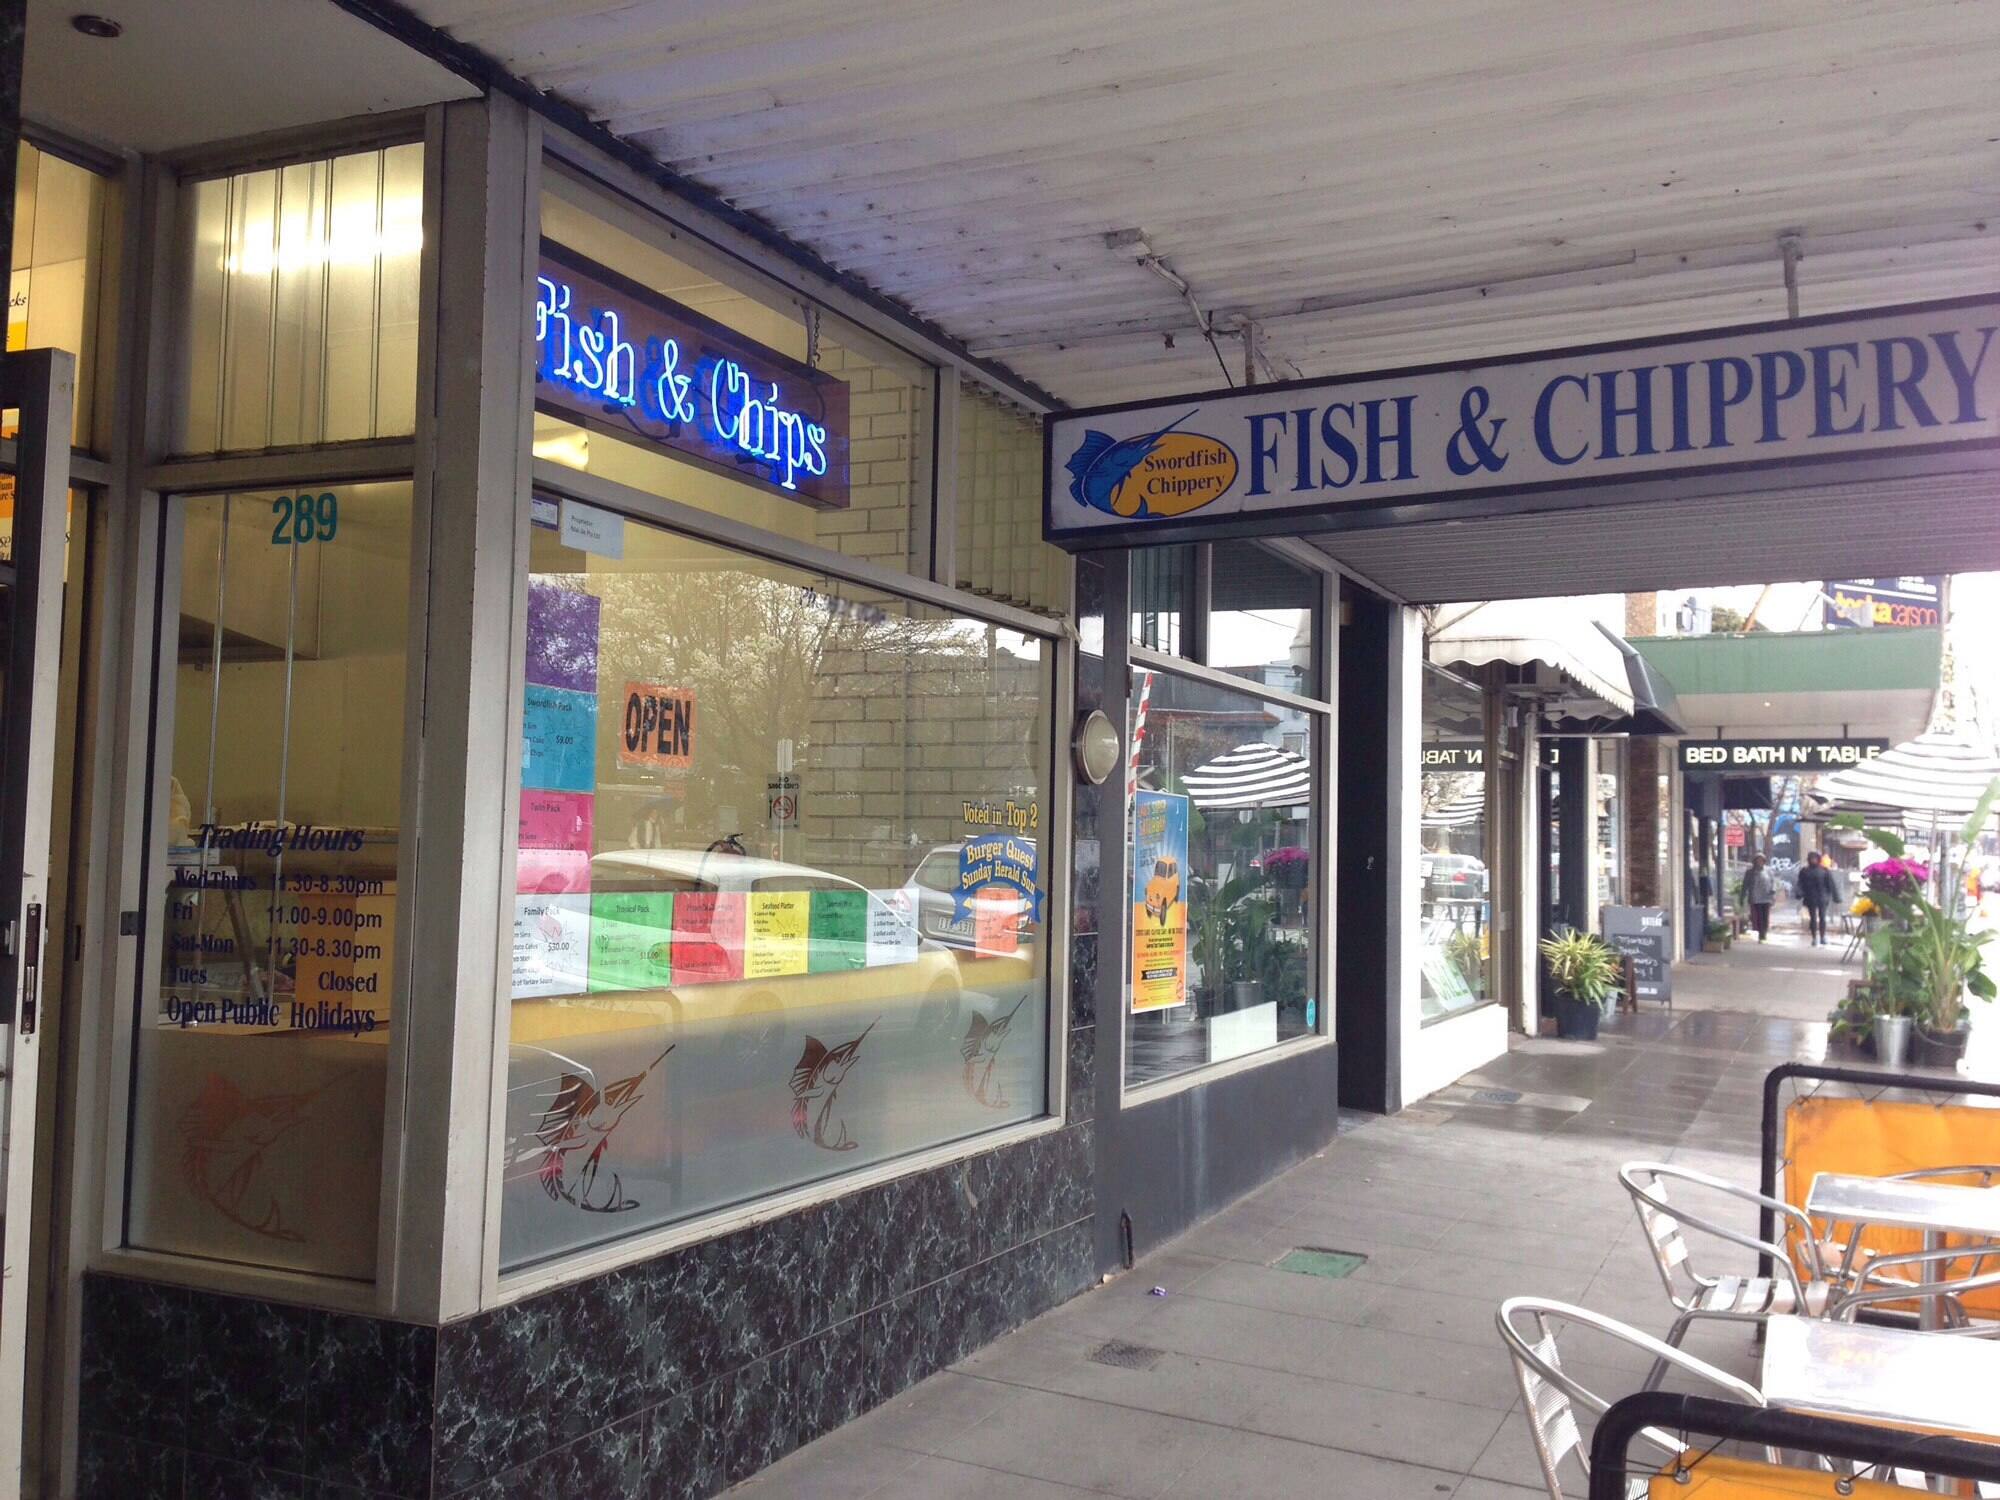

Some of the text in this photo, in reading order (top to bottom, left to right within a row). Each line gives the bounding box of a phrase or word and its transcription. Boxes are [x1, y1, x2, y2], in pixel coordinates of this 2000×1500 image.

[657, 339, 694, 424] &
[711, 358, 827, 489] Chips
[1244, 326, 1999, 497] FISH & CHIPPERY
[1144, 447, 1227, 473] Swordfish
[1146, 474, 1226, 497] Chippery
[271, 492, 338, 545] 289
[625, 692, 691, 756] OPEN
[1685, 746, 1881, 764] BED BATH N' TABLE
[962, 800, 1039, 834] Voted in Top 2
[200, 823, 365, 857] Trading Hours
[966, 840, 1034, 871] Burger Quest
[271, 874, 384, 898] 11.30-8.30pm
[962, 860, 1036, 895] Sunday Herald Sun
[172, 902, 382, 931] Fri 11.00-9.00pm
[524, 906, 545, 917] Family
[171, 933, 381, 963] Sat-Mon 11.30-8.30pm
[547, 942, 570, 952] $30.00
[170, 963, 377, 993] Tues Closed
[167, 995, 376, 1038] Open Public Holidays
